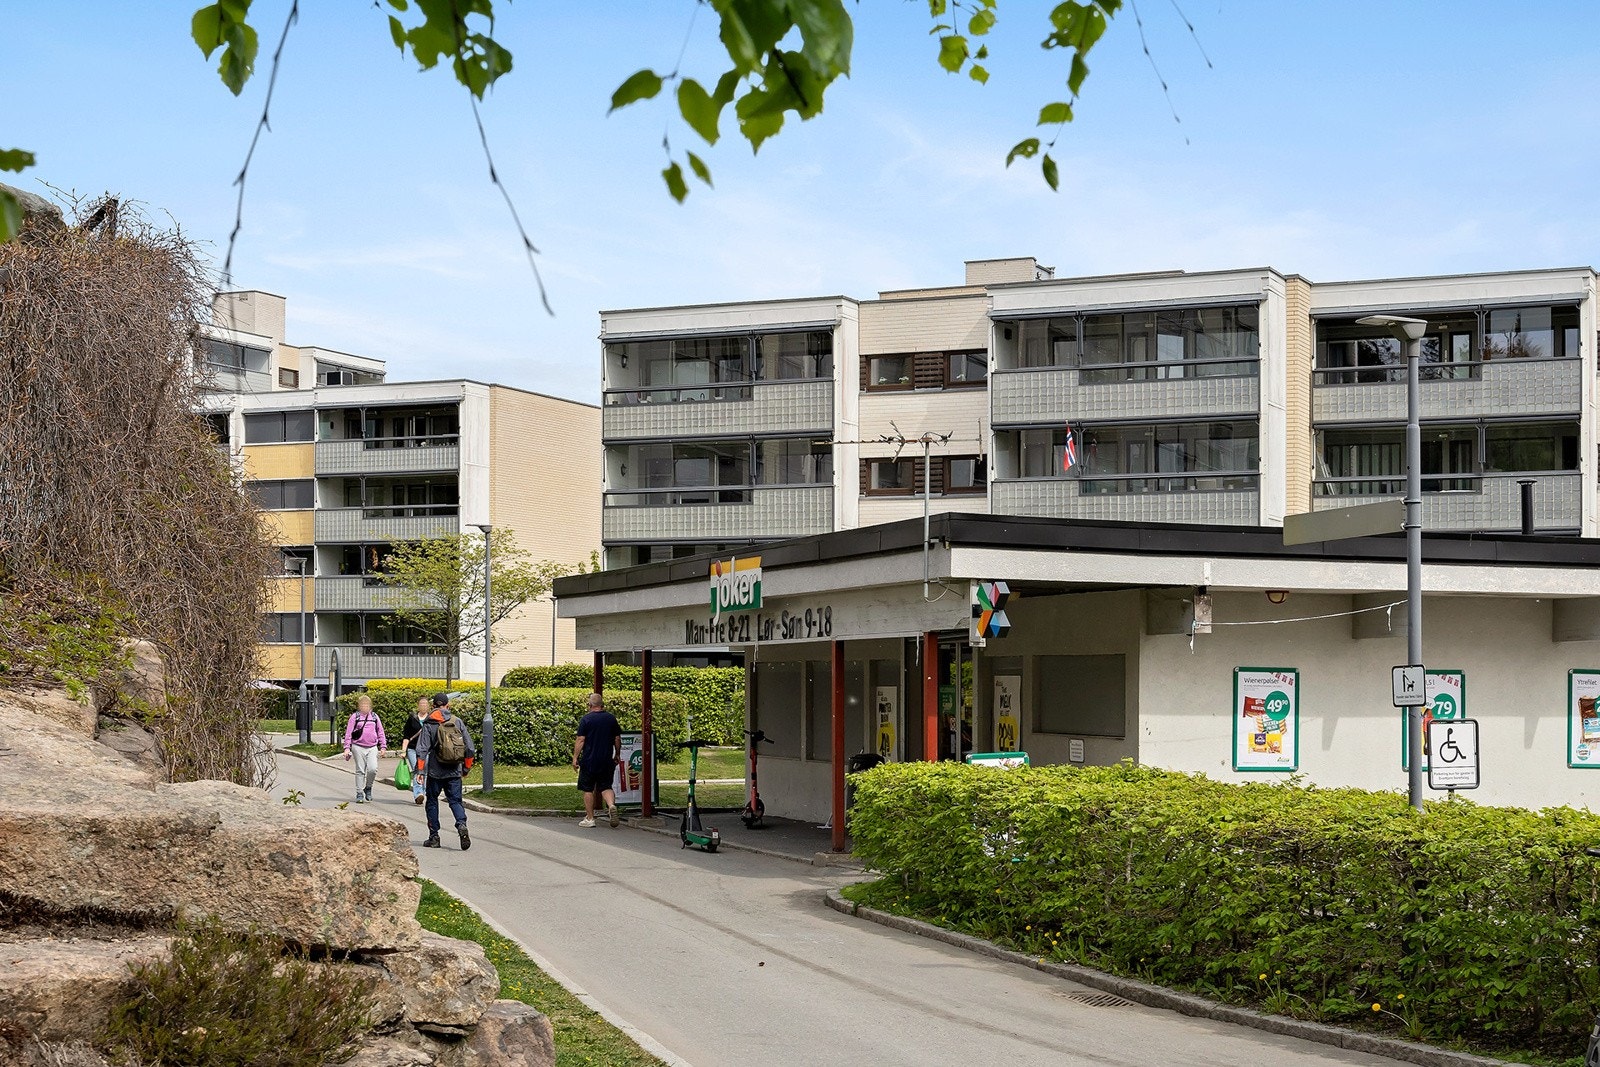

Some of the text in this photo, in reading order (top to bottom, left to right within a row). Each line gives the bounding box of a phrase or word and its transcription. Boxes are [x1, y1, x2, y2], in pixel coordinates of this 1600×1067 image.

[713, 556, 759, 626] joker
[685, 617, 725, 645] Man-Fre
[728, 614, 751, 642] 8-21
[804, 605, 833, 638] 9-18
[1435, 700, 1453, 715] 79
